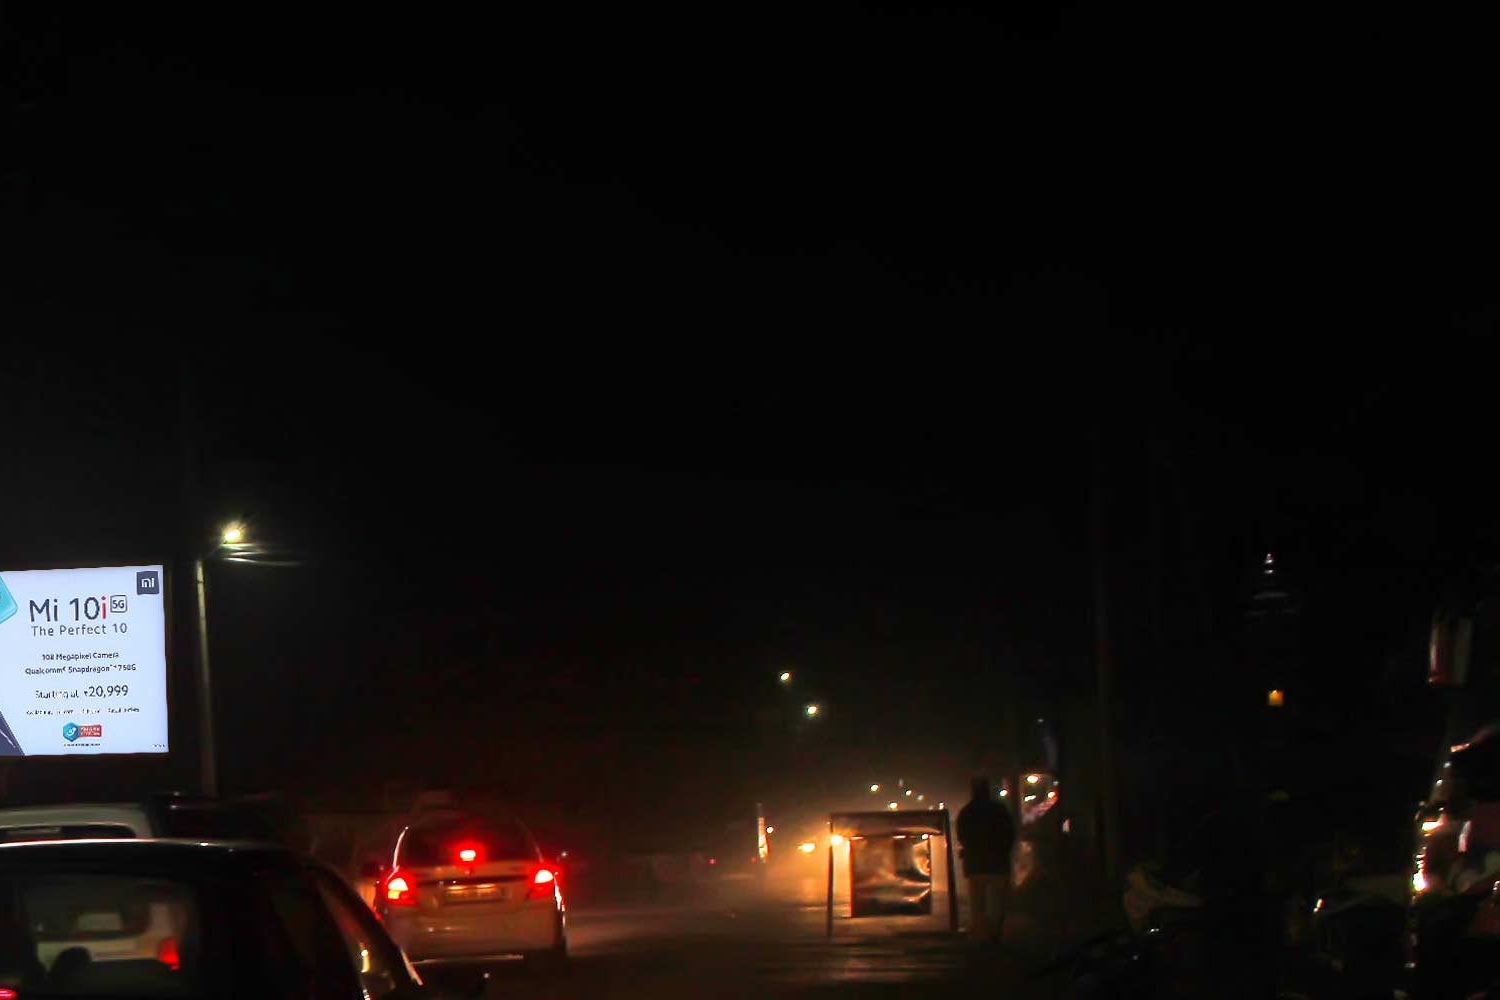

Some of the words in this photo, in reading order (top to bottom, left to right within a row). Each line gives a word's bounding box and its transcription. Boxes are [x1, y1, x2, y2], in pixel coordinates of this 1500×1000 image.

[29, 598, 58, 622] Mi
[69, 595, 107, 621] 10i
[111, 599, 126, 610] 5G
[31, 625, 54, 637] The
[59, 623, 107, 636] Perfect
[112, 622, 128, 634] 10
[56, 652, 92, 662] Megapixel
[93, 652, 120, 660] Camera
